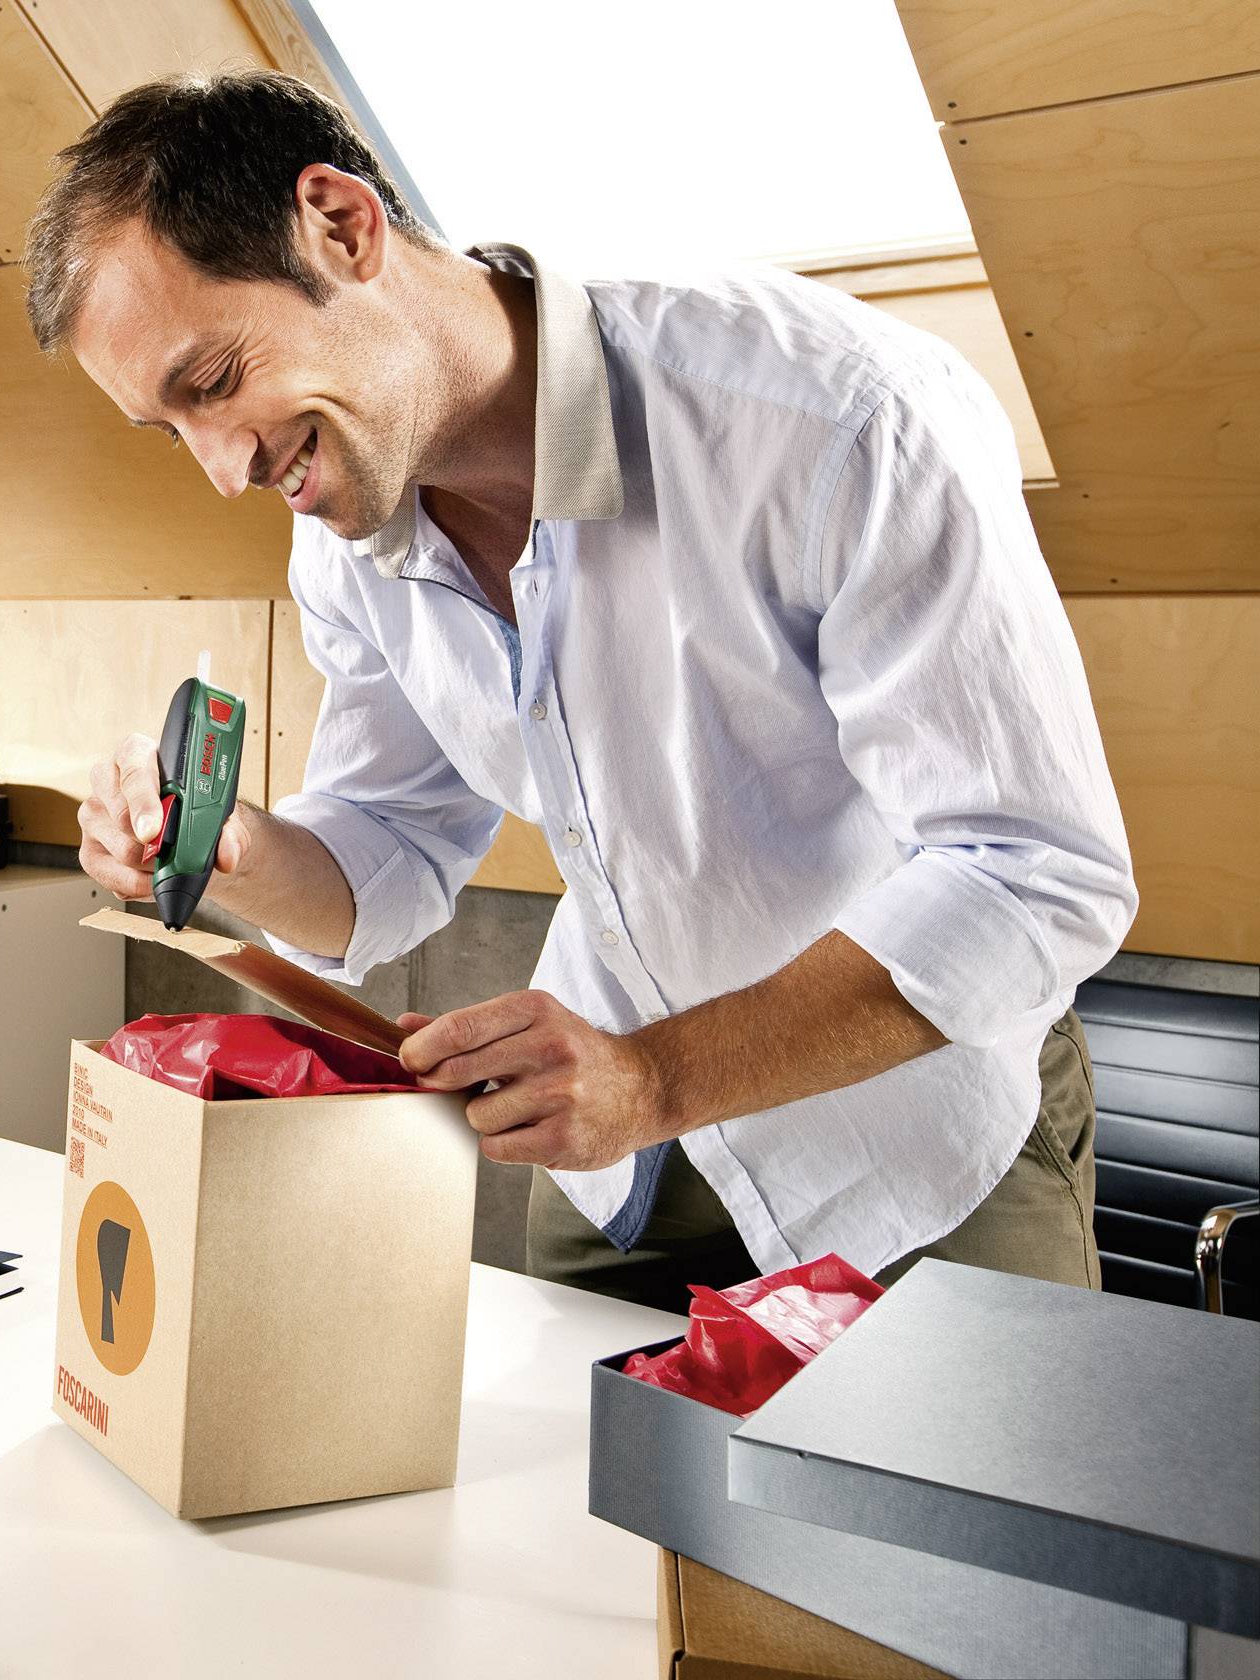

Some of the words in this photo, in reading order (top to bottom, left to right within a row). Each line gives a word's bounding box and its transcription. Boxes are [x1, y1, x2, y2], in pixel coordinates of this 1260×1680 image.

[200, 732, 216, 776] BOSCH
[218, 754, 228, 780] GluePen
[73, 1076, 93, 1096] DESIGN
[72, 1117, 86, 1135] MADE
[93, 1130, 108, 1148] ITALY
[57, 1364, 109, 1437] FOSCARINI
